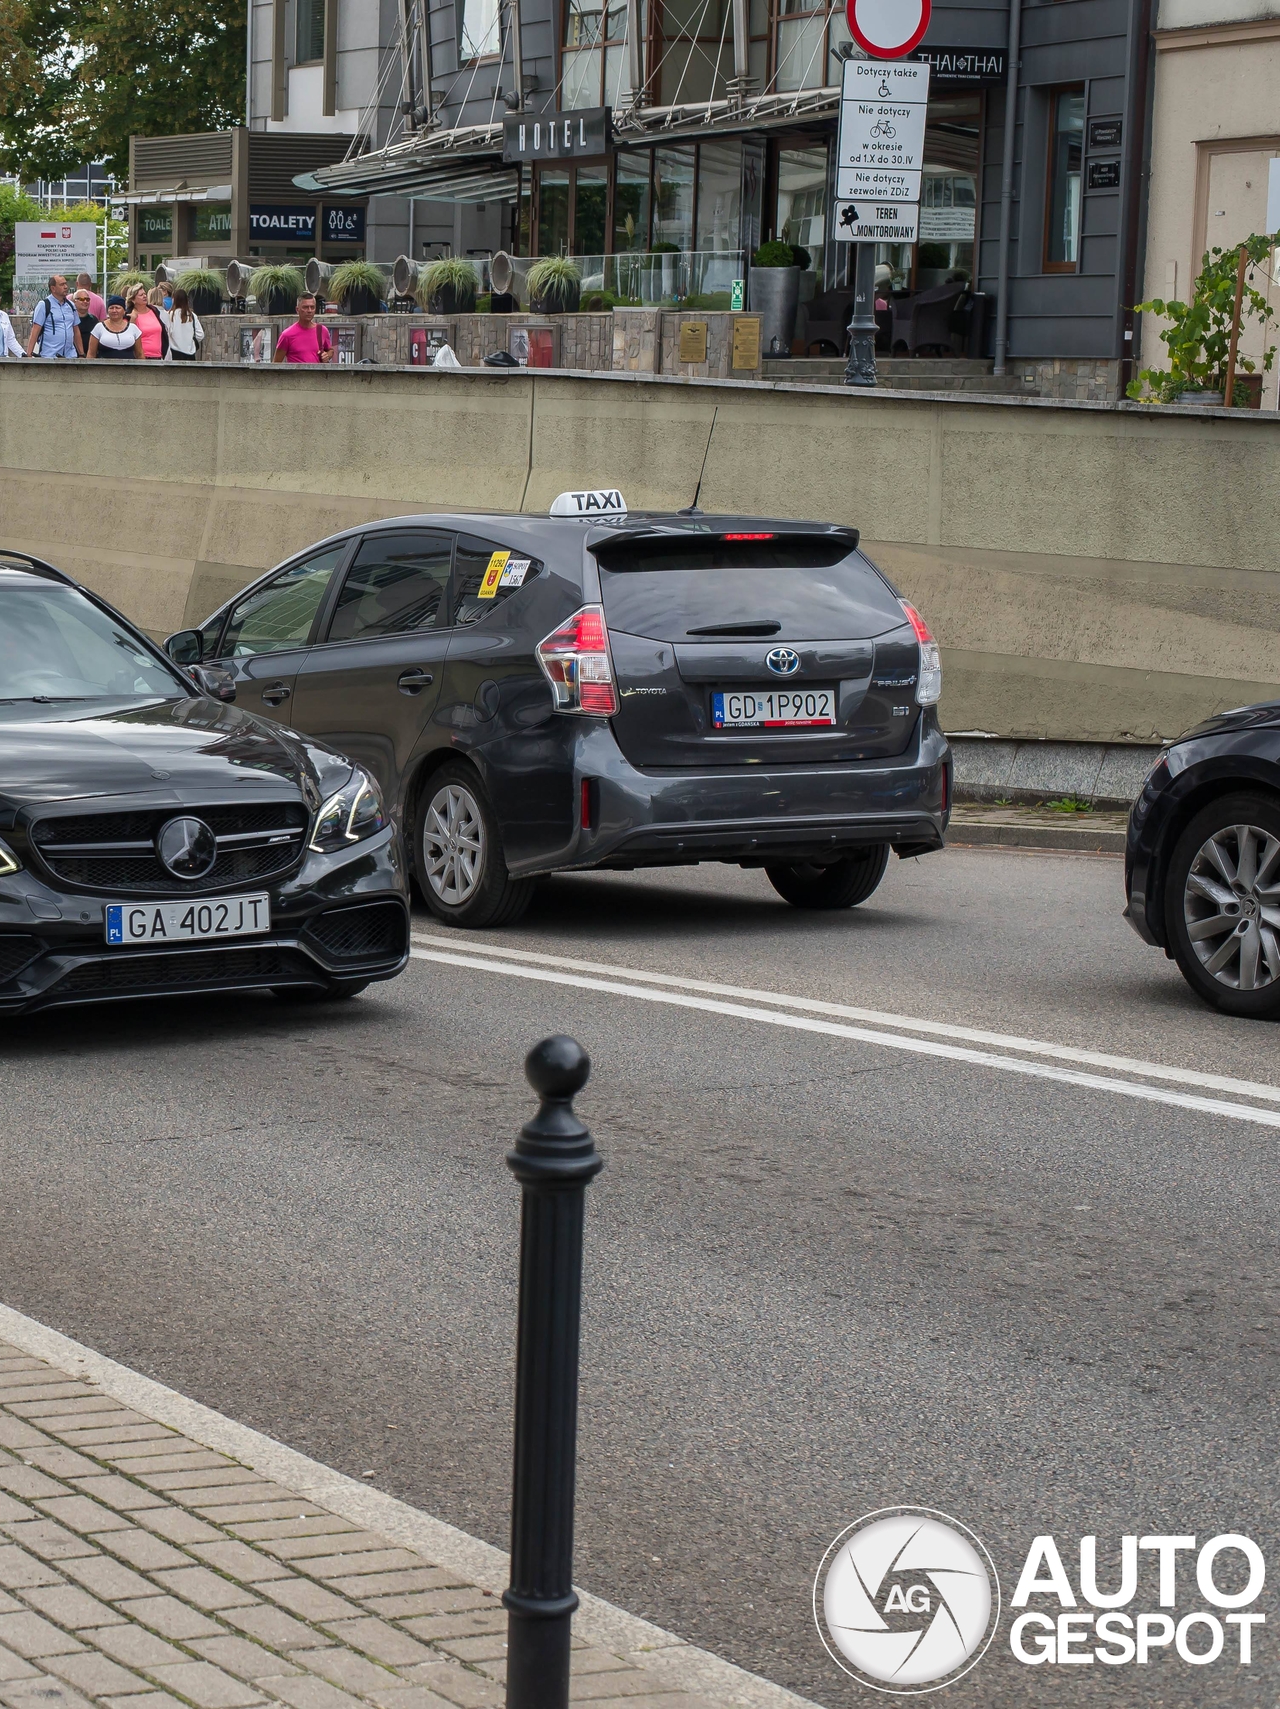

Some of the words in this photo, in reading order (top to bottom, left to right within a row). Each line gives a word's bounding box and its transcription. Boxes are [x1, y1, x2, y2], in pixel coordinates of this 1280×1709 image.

[918, 53, 956, 71] THAI
[964, 55, 1003, 73] THAI
[857, 66, 891, 79] Dotyczy
[893, 68, 918, 78] także
[858, 105, 874, 114] Nie
[877, 106, 911, 119] dotyczy
[519, 118, 587, 151] HOTEL
[871, 142, 903, 151] okresie
[849, 154, 861, 162] od
[863, 154, 876, 163] 1.X
[877, 155, 889, 164] do
[891, 155, 914, 165] 30.IV
[855, 173, 870, 182] Nie
[873, 174, 905, 185] dotyczy
[849, 187, 888, 196] zezwoleń
[890, 187, 910, 197] ZDiZ
[876, 207, 898, 220] TEREN
[209, 214, 232, 230] ATM
[250, 214, 315, 229] TOALETY
[856, 225, 914, 238] MONITOROWANY
[571, 492, 622, 511] TAXI
[490, 559, 506, 568] 11292
[729, 695, 756, 719] GD
[766, 694, 829, 718] 1P902
[129, 909, 167, 938] GA
[180, 899, 263, 935] 402JT
[110, 929, 121, 937] PL
